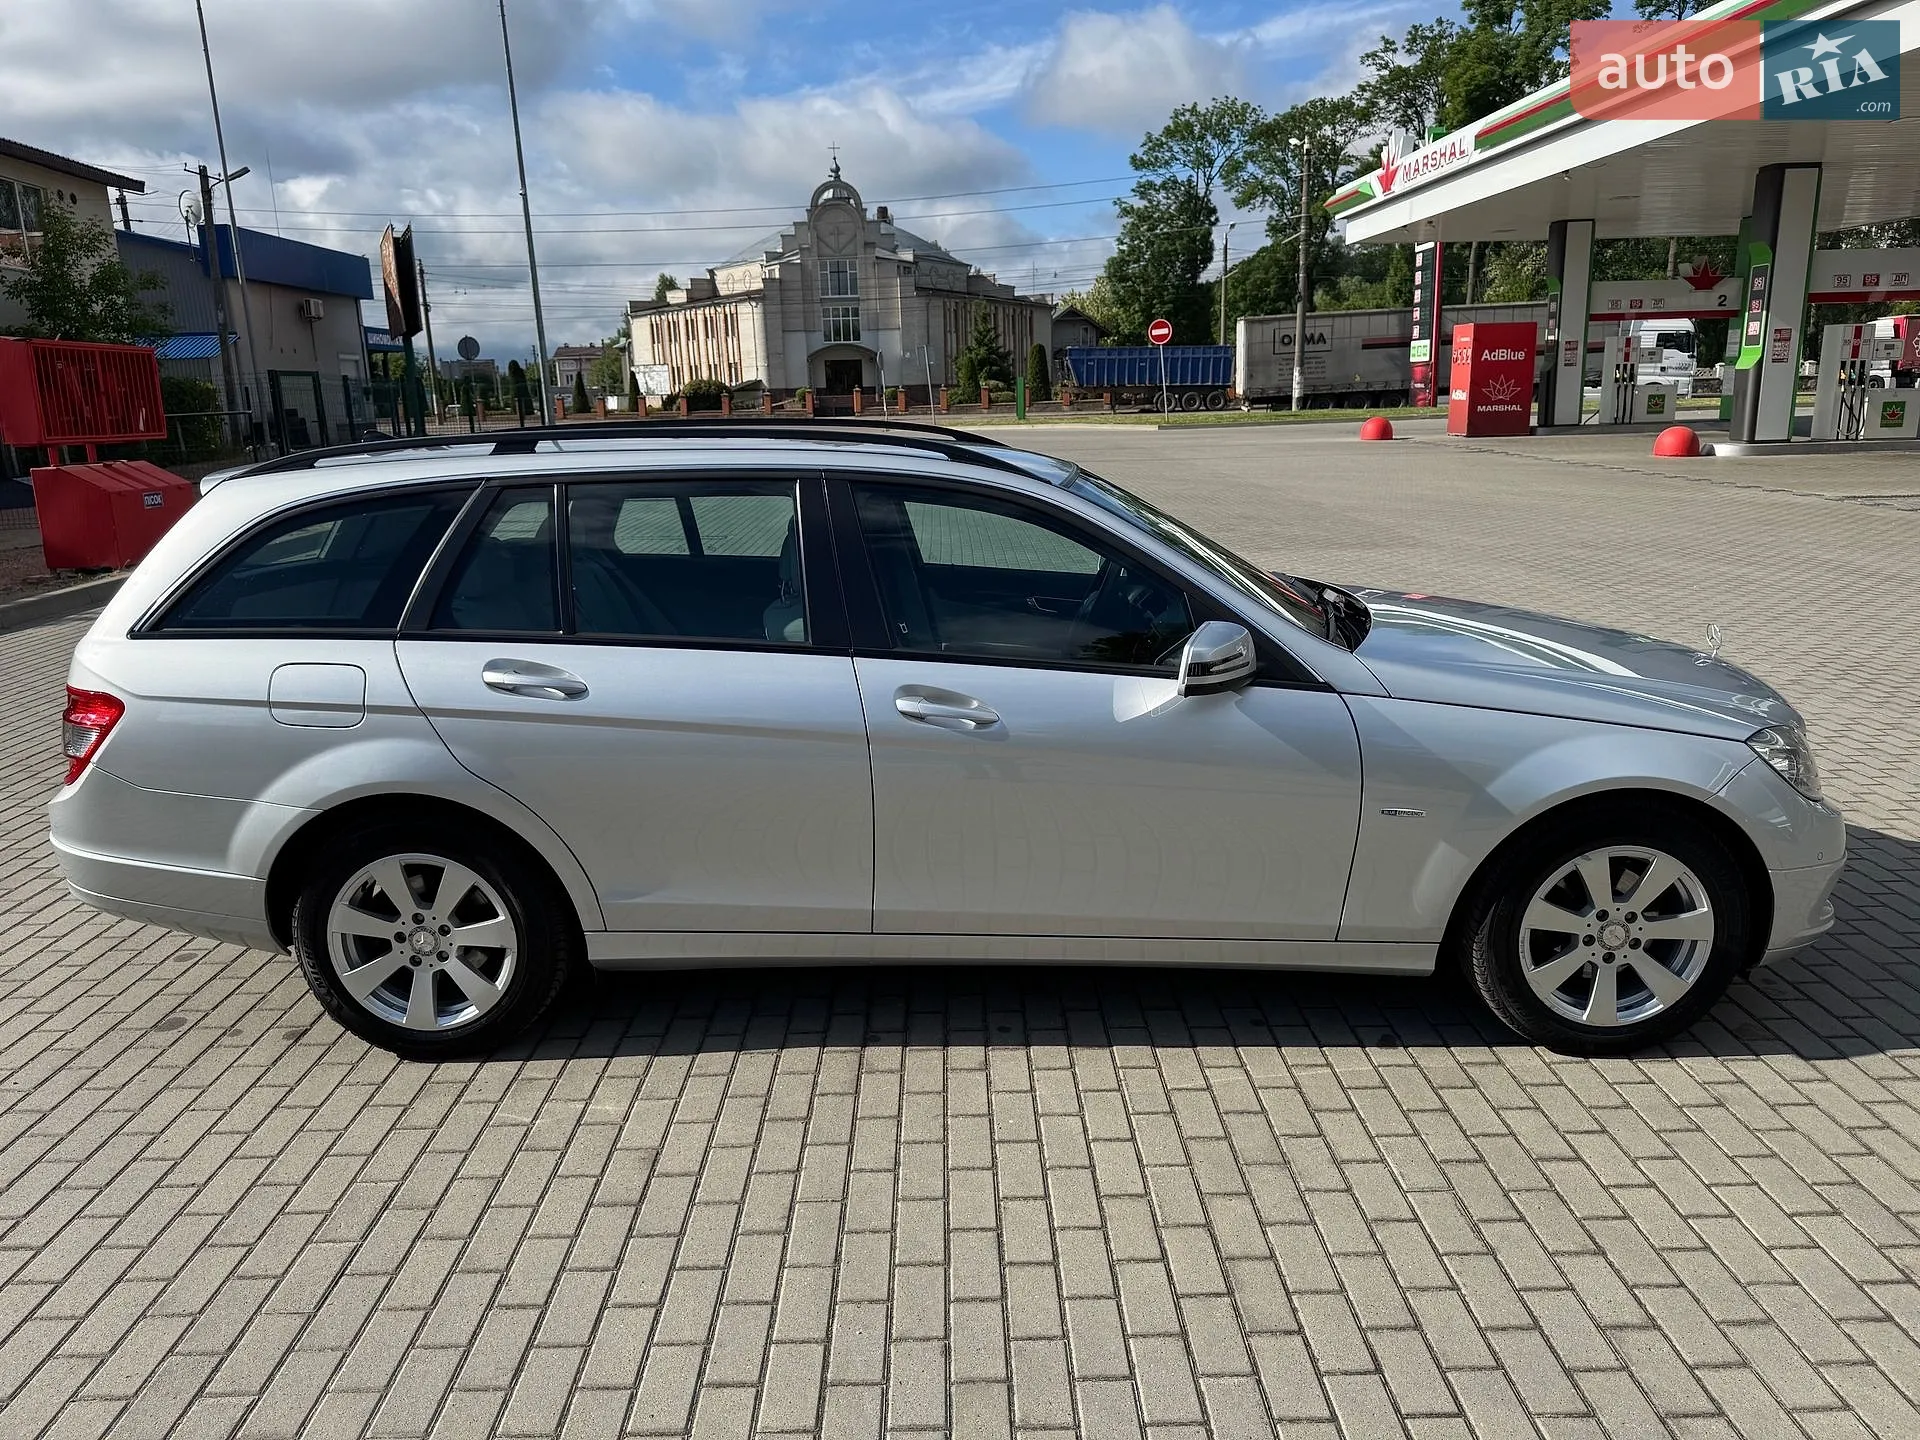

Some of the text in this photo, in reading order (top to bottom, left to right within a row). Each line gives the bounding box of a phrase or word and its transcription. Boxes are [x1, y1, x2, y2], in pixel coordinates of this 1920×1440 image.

[1402, 136, 1468, 182] MARSHAL
[1836, 275, 1877, 284] 95 95
[1717, 294, 1728, 307] 2
[1281, 332, 1327, 346] OMA
[1481, 348, 1526, 361] AdBlue
[1477, 404, 1523, 412] MARSHAL
